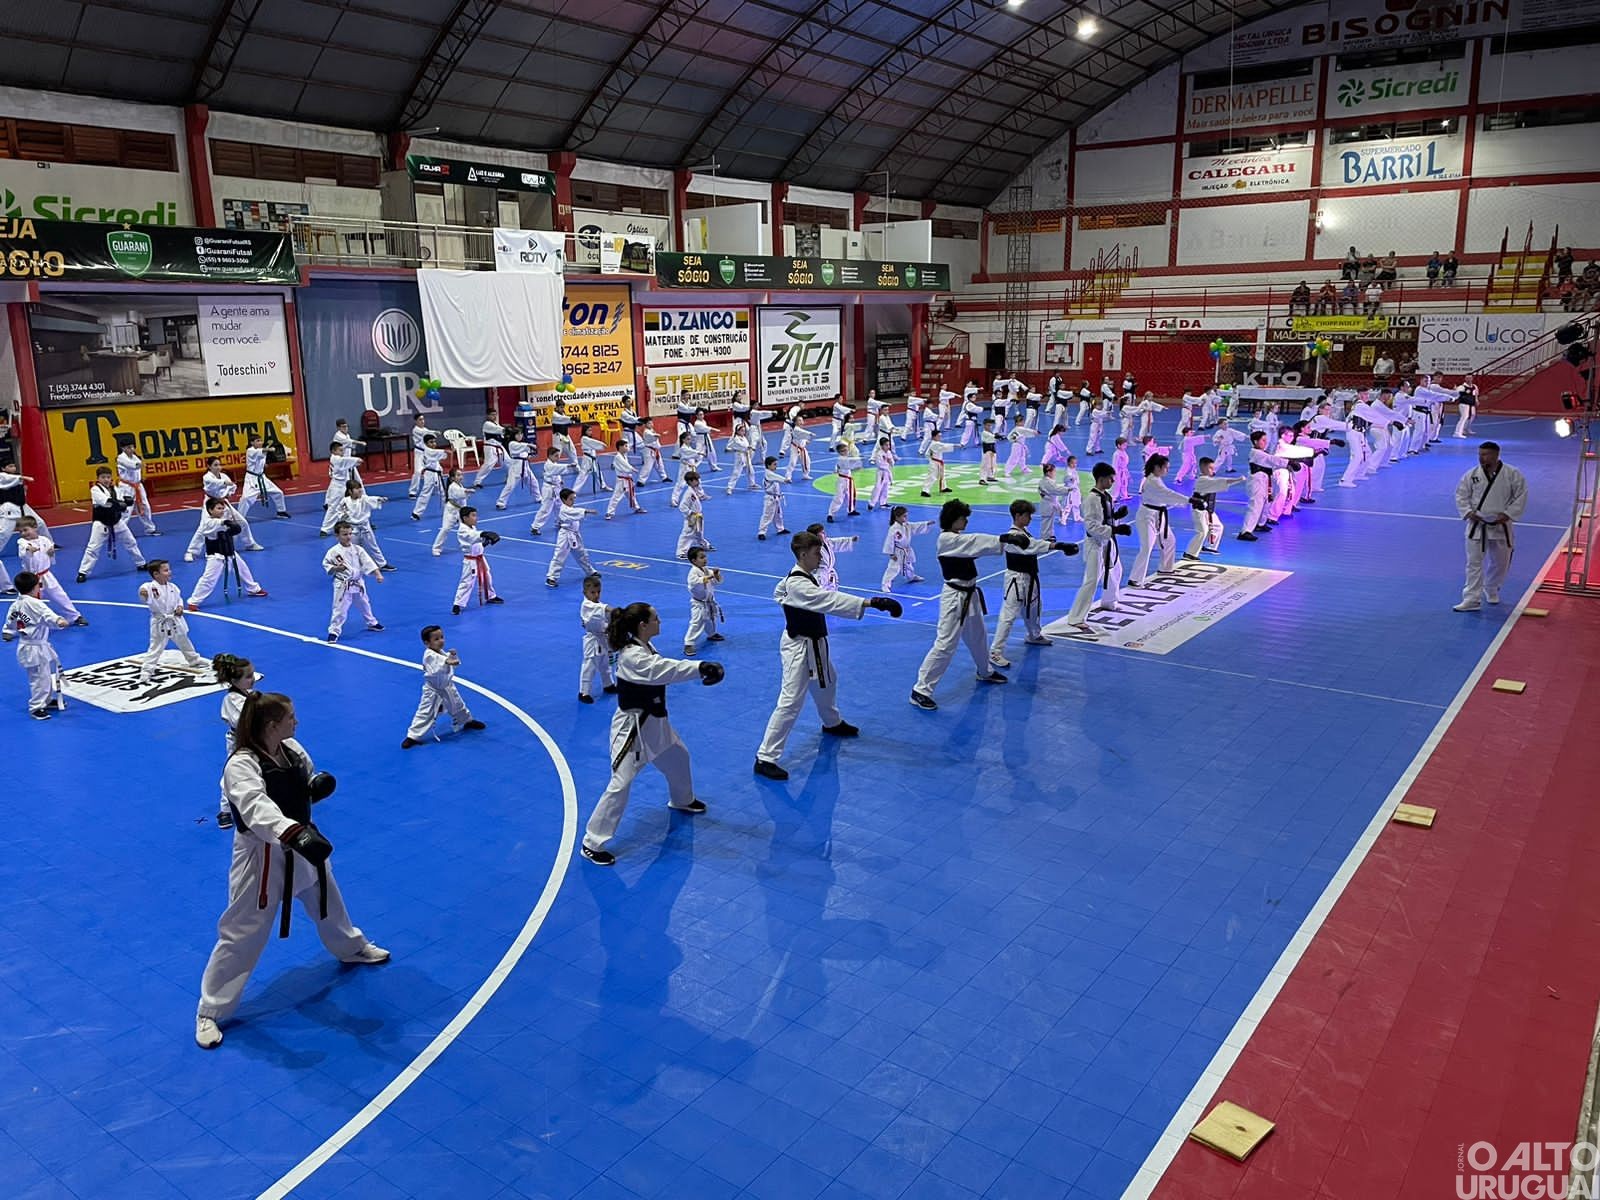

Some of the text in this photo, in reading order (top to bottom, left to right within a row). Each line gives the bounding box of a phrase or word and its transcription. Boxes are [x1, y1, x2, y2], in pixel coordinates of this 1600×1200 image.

[1302, 0, 1510, 46] BISOGNIN
[1368, 71, 1459, 100] Sicredi
[1191, 82, 1315, 116] DERMAPELLE
[1360, 143, 1421, 156] SUPERMERCADO
[1340, 141, 1446, 184] BARRIL
[1187, 163, 1297, 181] CALEGARI
[1201, 182, 1229, 191] INJEÇÃO
[33, 195, 177, 226] Sicredi
[112, 240, 149, 252] GUARANI
[683, 255, 702, 266] SEJA
[792, 260, 808, 270] SEJA
[211, 305, 270, 319] A gente ama
[211, 320, 242, 331] mudar
[1420, 315, 1540, 344] São Lucas
[212, 336, 236, 345] com
[645, 334, 685, 346] MATERIAIS
[689, 334, 700, 345] DE
[592, 344, 620, 358] 8125
[216, 362, 268, 377] Todeschini
[592, 360, 623, 374] 3247
[654, 370, 747, 396] STEMETAL
[767, 372, 830, 389] SPORTS
[1242, 371, 1302, 387] KTO
[56, 383, 70, 394] (55)
[70, 382, 88, 392] 3744
[88, 381, 105, 391] 4301
[50, 391, 82, 401] Frederico
[62, 409, 281, 465] TROMBETTA
